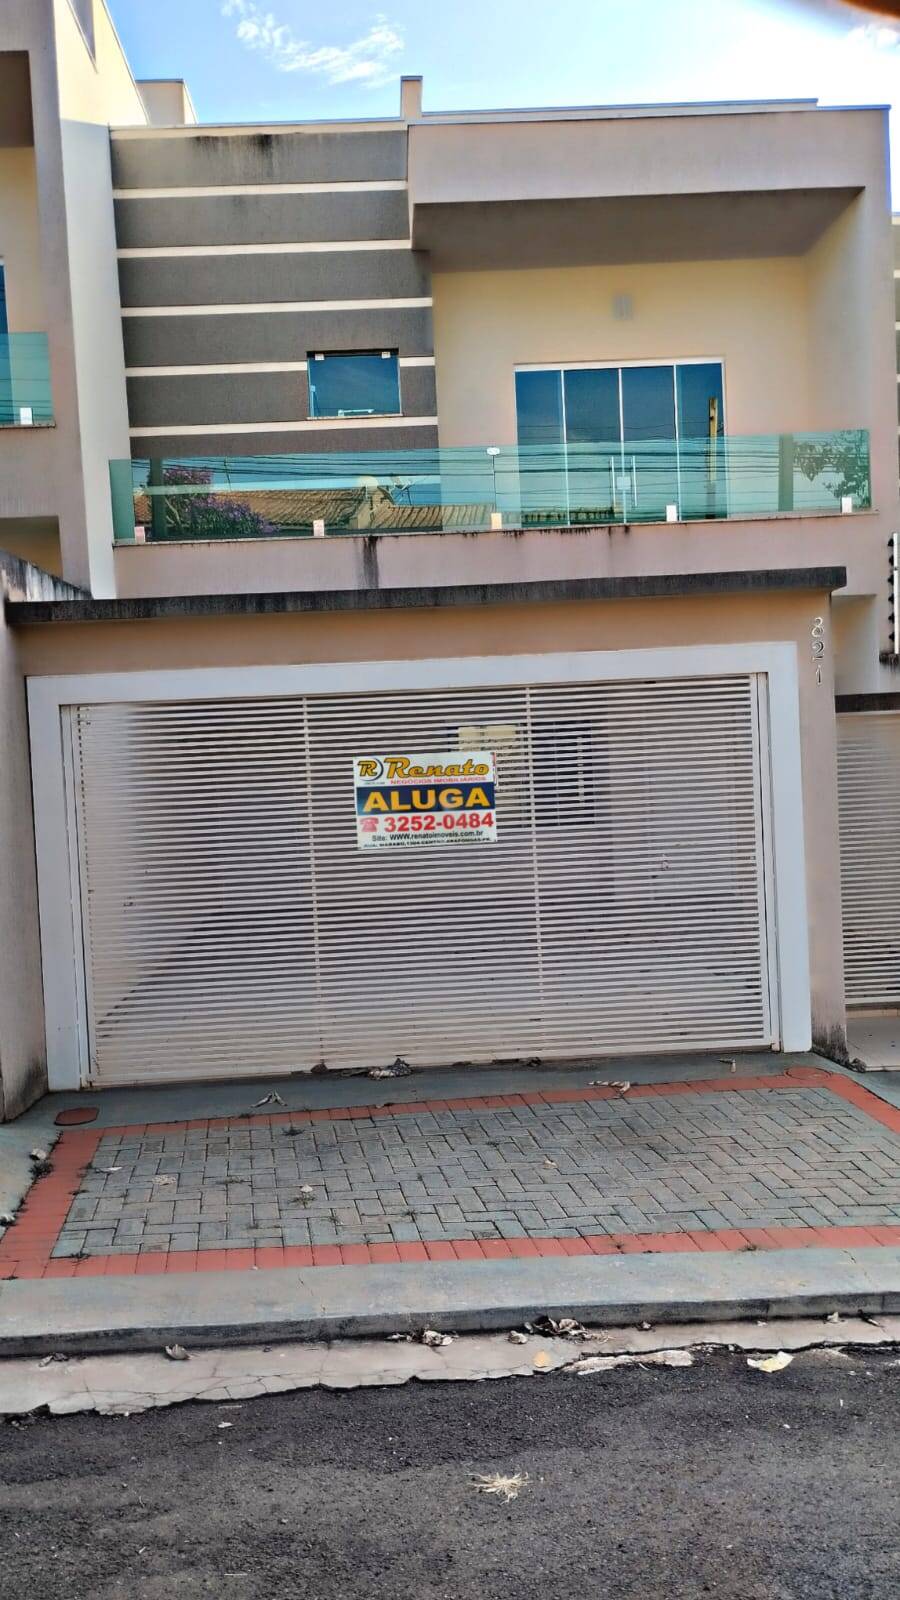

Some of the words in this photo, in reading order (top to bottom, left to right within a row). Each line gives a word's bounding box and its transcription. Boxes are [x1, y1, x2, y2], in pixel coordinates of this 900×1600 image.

[811, 616, 824, 685] 821
[384, 757, 489, 779] Renato
[363, 787, 490, 813] ALUGA
[384, 812, 494, 833] 3252-0484
